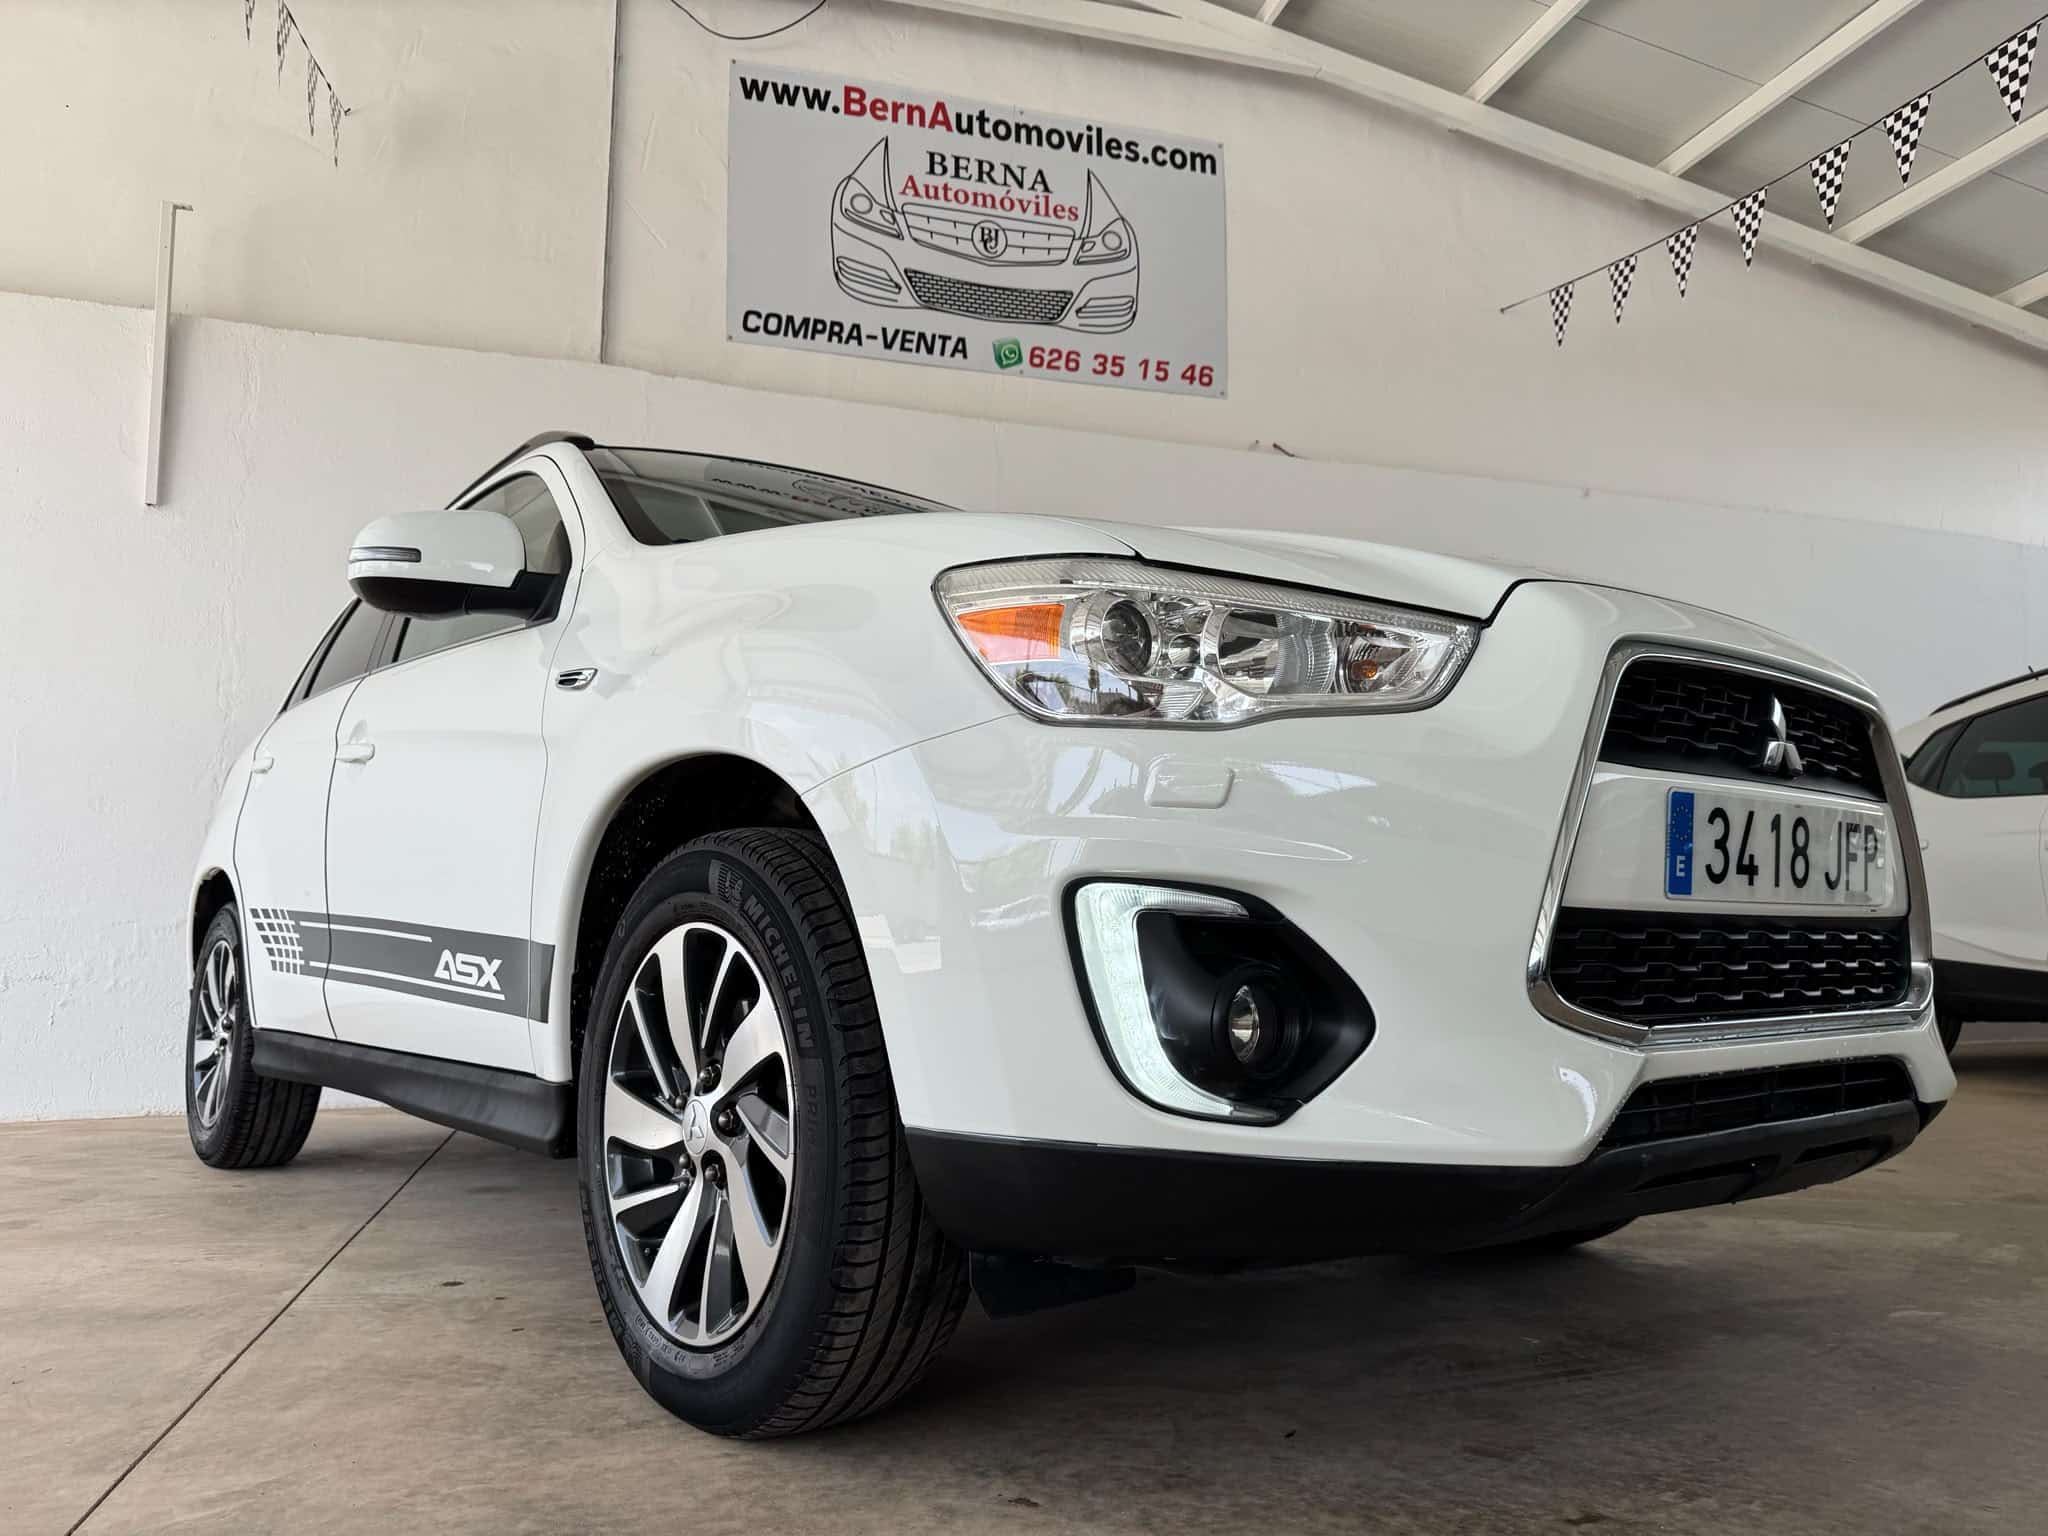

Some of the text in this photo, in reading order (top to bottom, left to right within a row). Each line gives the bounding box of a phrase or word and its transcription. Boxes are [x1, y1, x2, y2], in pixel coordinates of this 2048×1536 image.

[739, 76, 1217, 175] www.BernAutomoviles.com
[926, 151, 1053, 194] BERNA
[900, 175, 1080, 222] Automóviles
[742, 310, 968, 359] COMPRA-VENTA
[1029, 345, 1214, 387] 626 35 15 46
[1676, 855, 1686, 877] E
[1705, 807, 1810, 888] 3418
[1824, 821, 1878, 892] JFP
[433, 949, 502, 990] ASX
[744, 893, 815, 1049] MICHELIN
